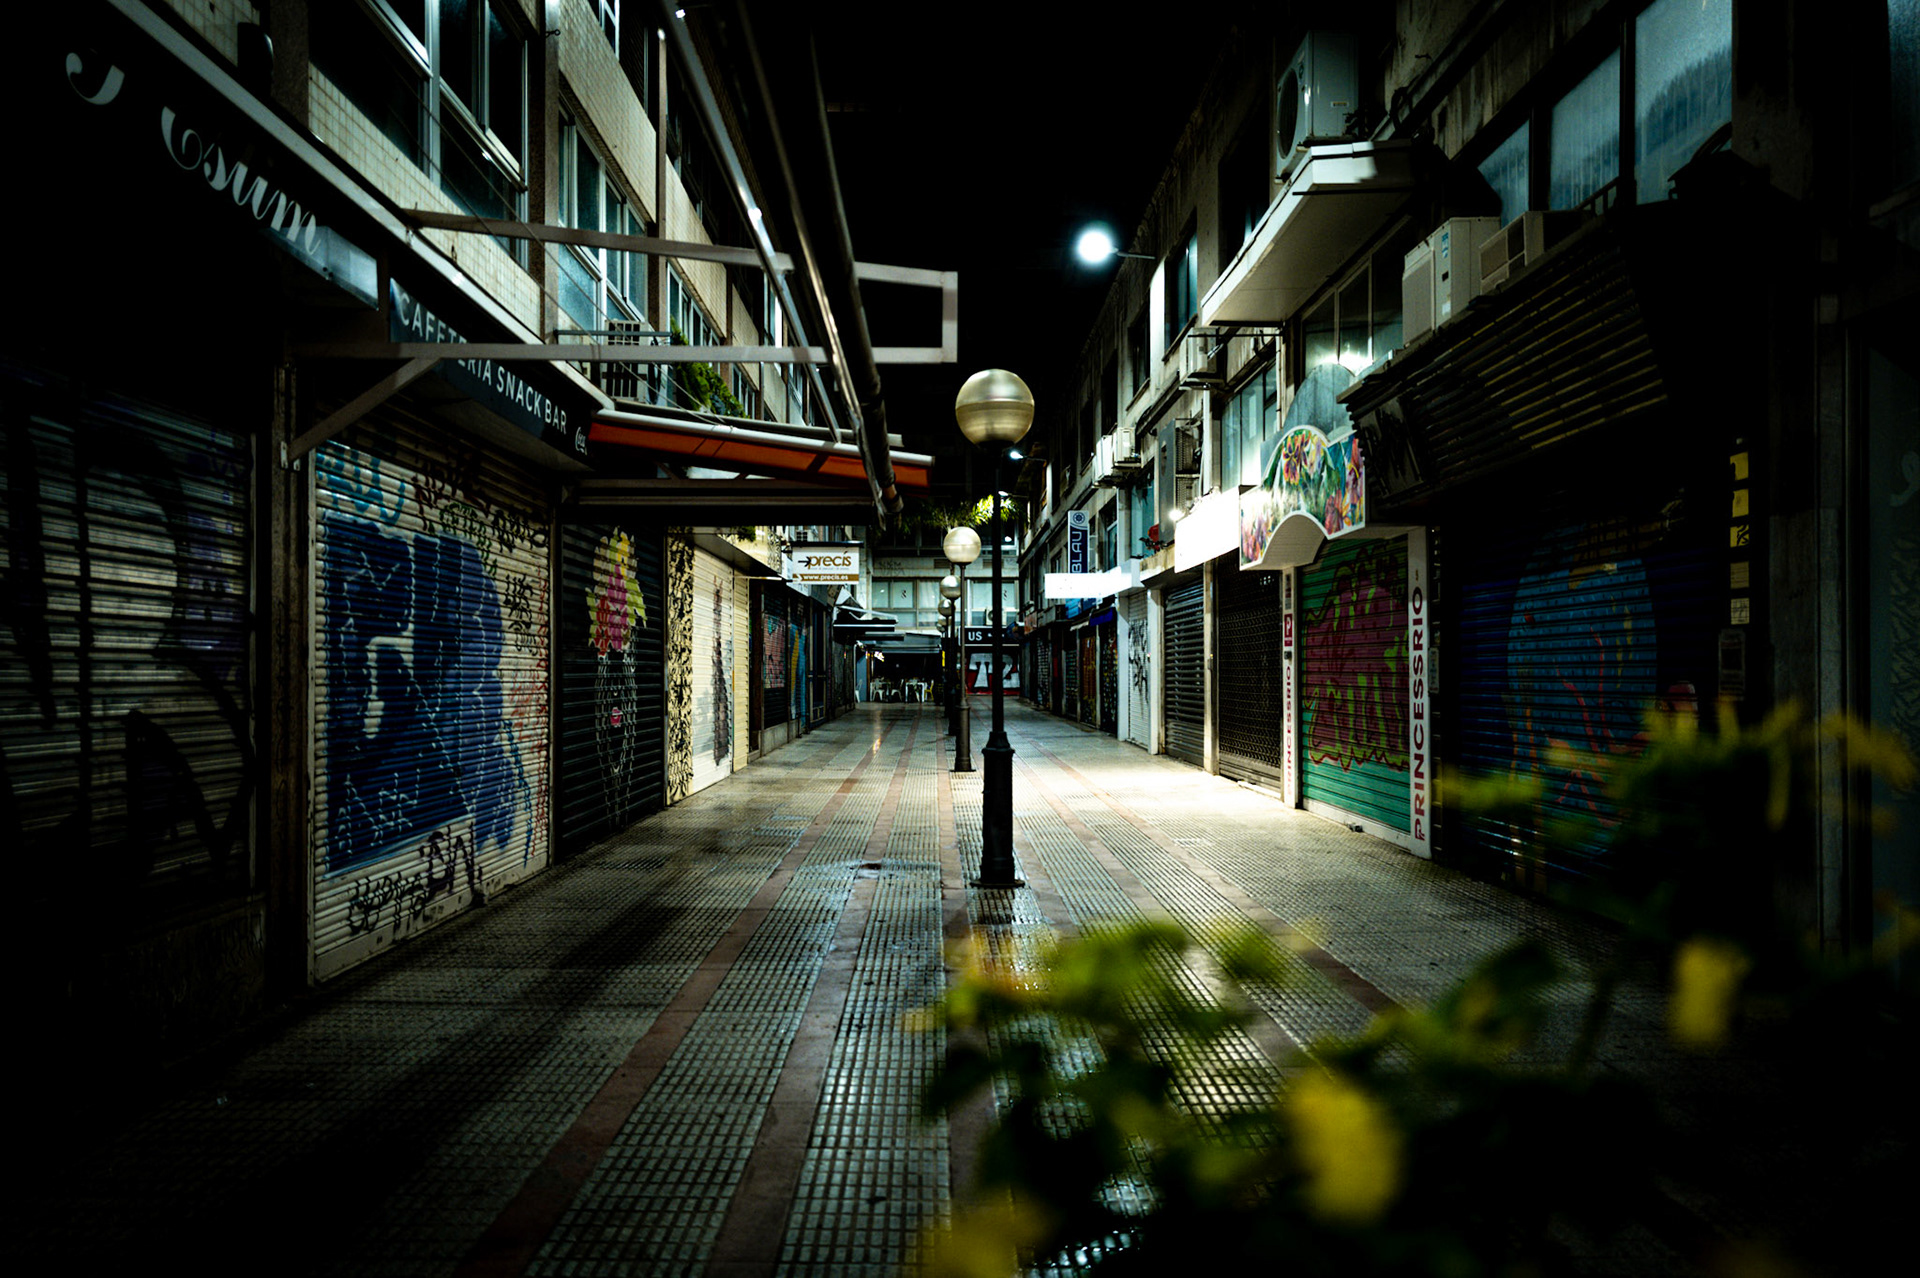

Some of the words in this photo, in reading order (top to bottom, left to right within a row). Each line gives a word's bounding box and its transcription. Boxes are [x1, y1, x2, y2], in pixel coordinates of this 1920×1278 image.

[496, 365, 542, 418] SNACK
[544, 398, 568, 435] BAR
[803, 574, 849, 582] www.precis.es
[1071, 531, 1083, 573] BLAU
[1412, 587, 1425, 841] PRINCESSRIO
